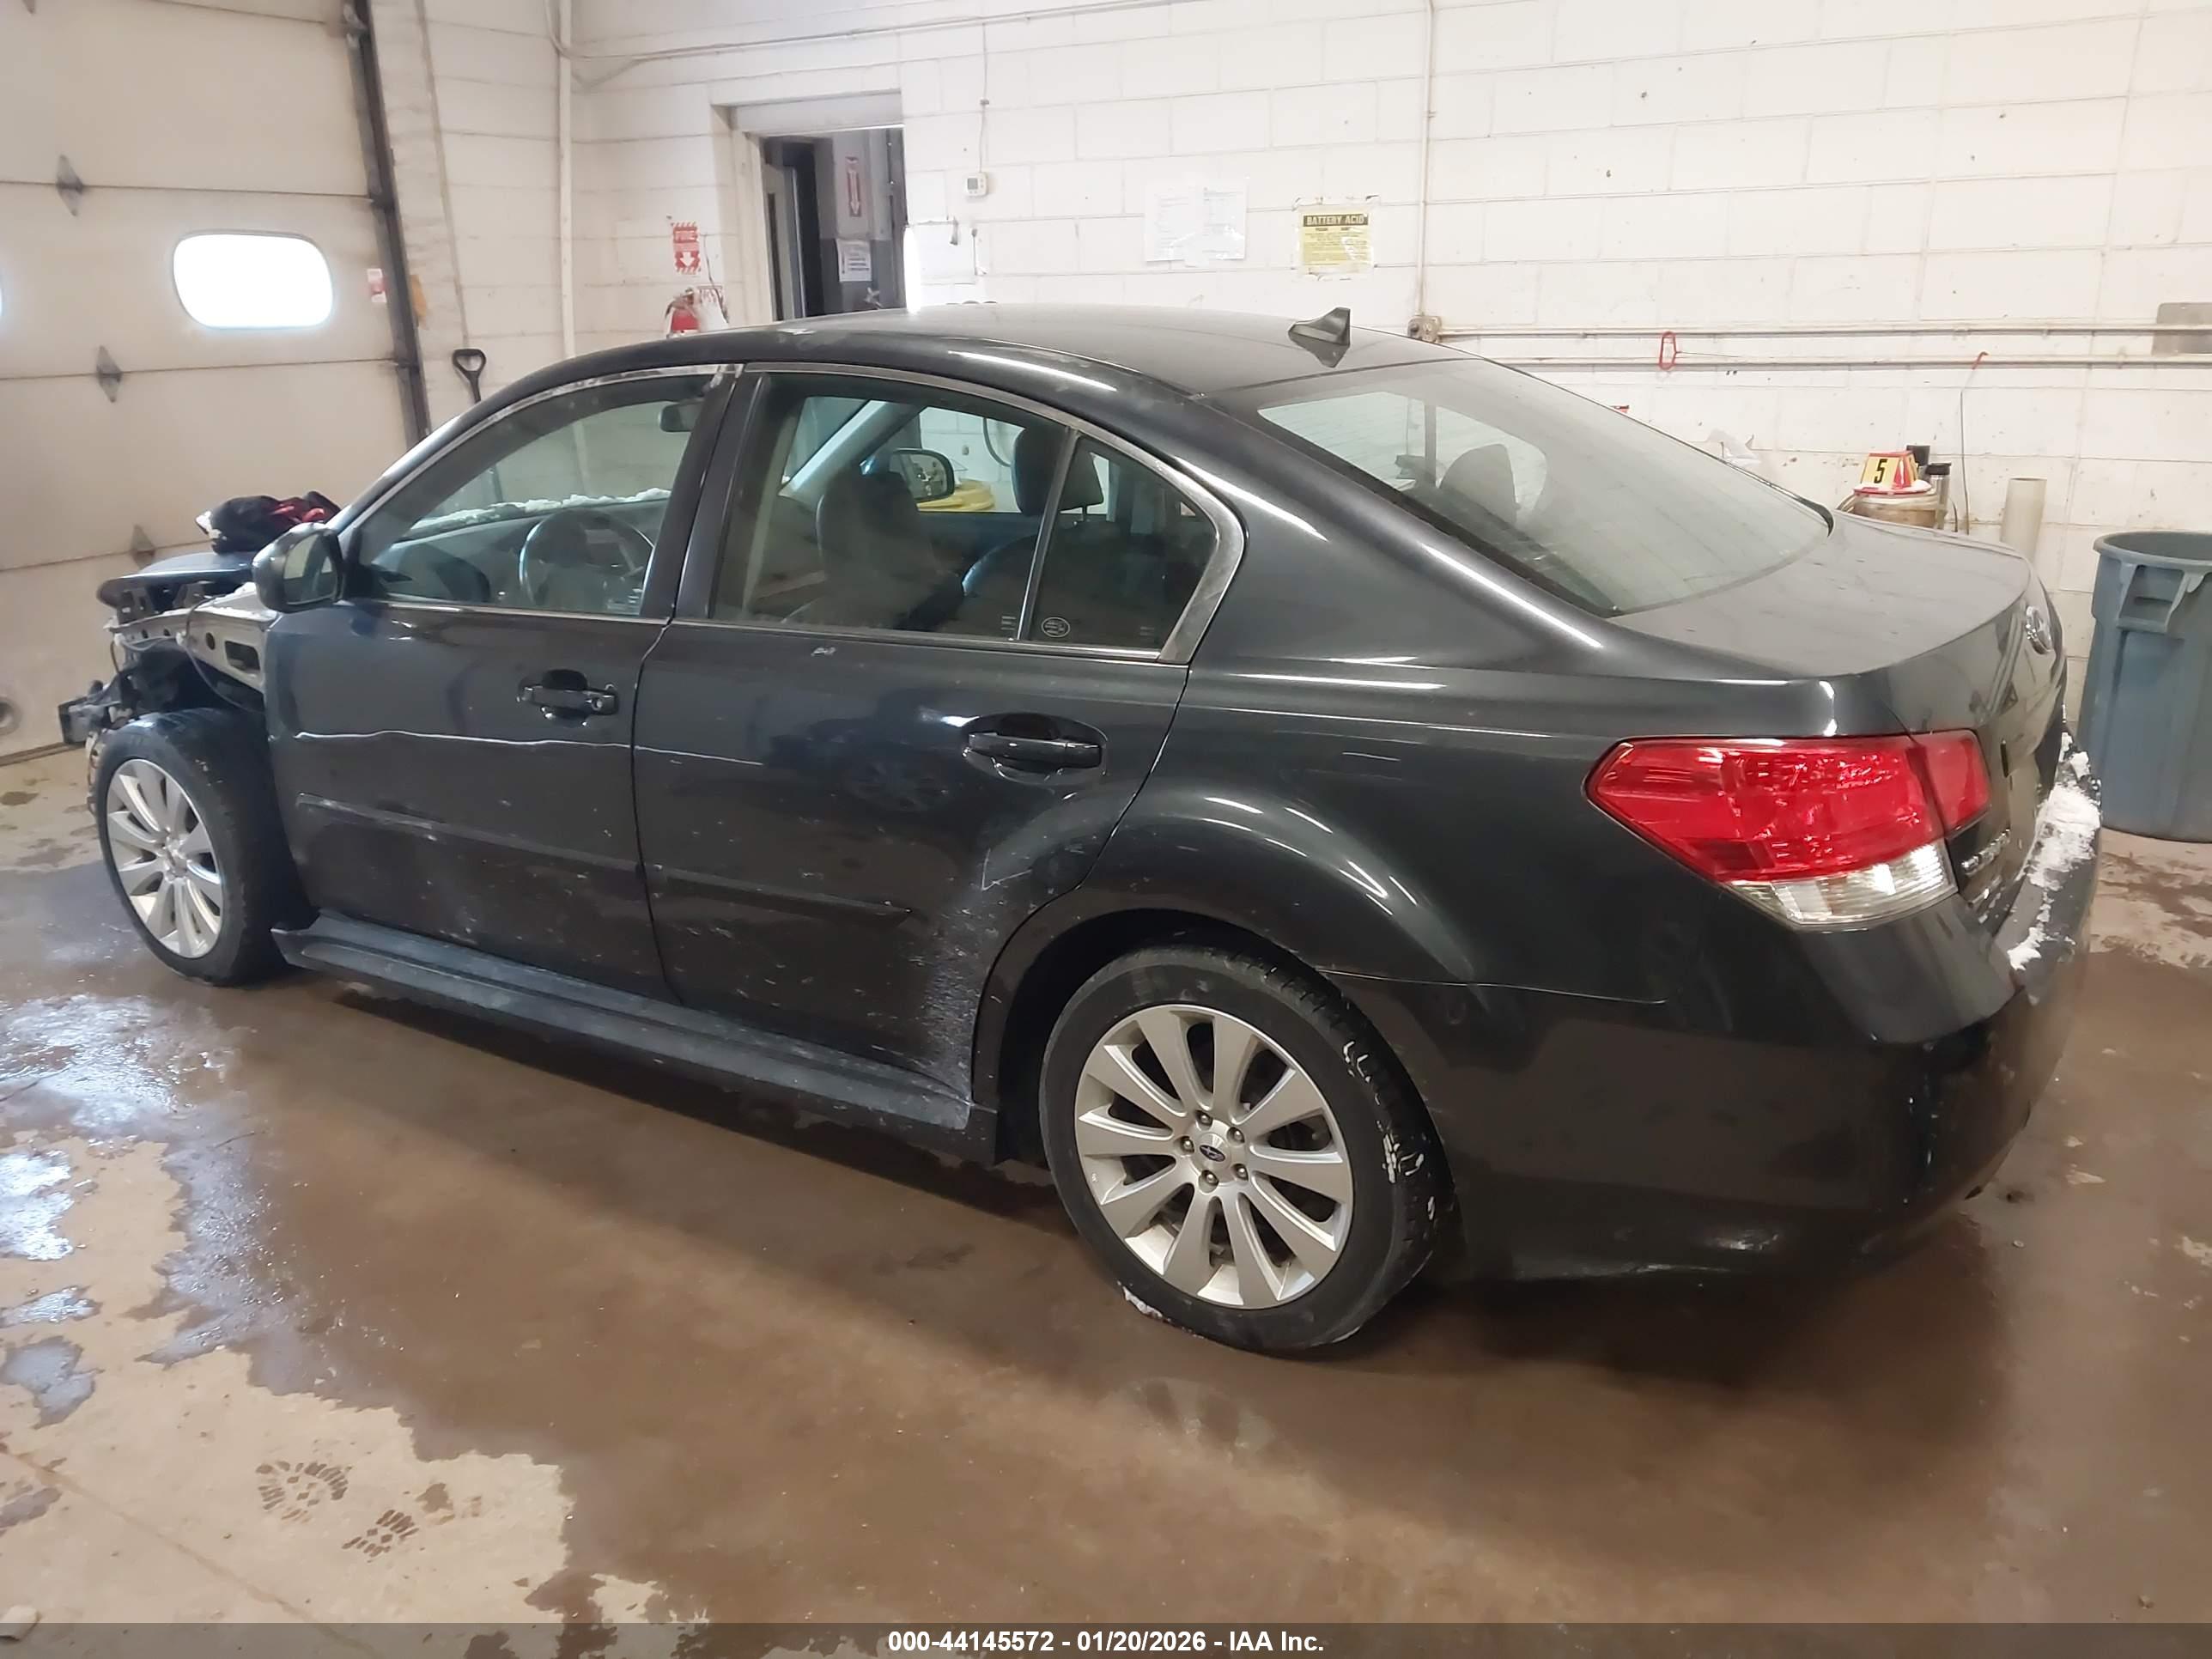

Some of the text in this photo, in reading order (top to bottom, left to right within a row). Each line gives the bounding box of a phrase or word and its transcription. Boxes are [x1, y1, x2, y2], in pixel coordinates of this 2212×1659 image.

[1306, 214, 1365, 226] BATTERY ACID
[1873, 458, 1889, 484] 5
